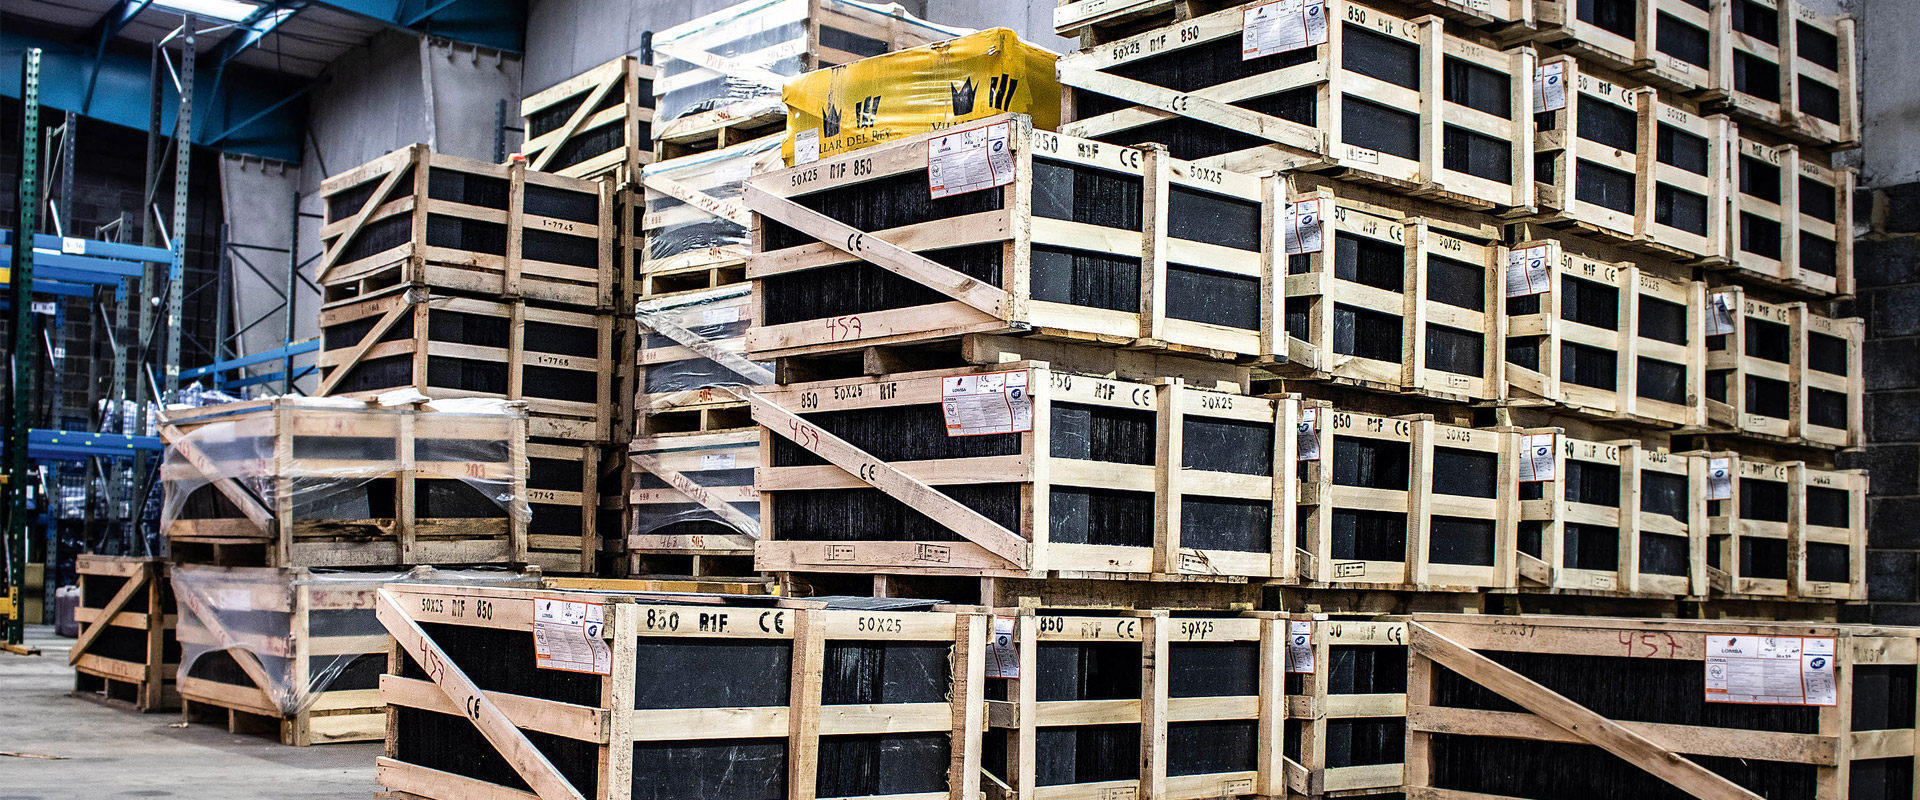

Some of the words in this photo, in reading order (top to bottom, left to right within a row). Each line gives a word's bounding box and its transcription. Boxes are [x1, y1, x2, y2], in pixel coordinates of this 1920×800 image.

[1348, 6, 1366, 24] 850
[1112, 42, 1140, 60] 50X25
[1180, 25, 1200, 43] 850
[1577, 74, 1588, 90] 50
[1621, 89, 1634, 106] CE
[1667, 108, 1687, 124] 50X25
[818, 140, 842, 154] LLAR
[846, 134, 868, 146] DEL
[1034, 132, 1058, 153] 850
[1120, 149, 1138, 169] CE
[1190, 166, 1222, 185] 50X25
[791, 168, 818, 187] 50X25
[854, 158, 872, 176] 850
[1335, 208, 1346, 222] 50
[1389, 225, 1402, 242] CE
[1438, 236, 1462, 252] 50X25
[848, 234, 862, 252] CE
[1561, 254, 1572, 269] 50
[1604, 268, 1616, 282] CE
[1640, 276, 1660, 292] 50X25
[1776, 308, 1787, 322] CE
[826, 316, 862, 341] 457
[801, 392, 818, 409] 850
[834, 384, 862, 400] 50X25
[880, 382, 897, 400] R1F
[1132, 388, 1150, 407] CE
[1202, 395, 1234, 410] 50X25
[789, 418, 818, 452] 457
[1333, 414, 1352, 429] 850
[1395, 420, 1409, 436] CE
[1446, 428, 1470, 442] 50X25
[1566, 440, 1575, 458] 50
[1606, 446, 1617, 460] CE
[860, 463, 876, 482] CE
[530, 492, 554, 500] -7742
[422, 598, 444, 614] 50X25
[476, 599, 492, 621] 850
[646, 608, 680, 632] 850
[758, 610, 785, 634] CE
[858, 616, 902, 634] 50X25
[1040, 616, 1064, 633] 850
[1116, 620, 1134, 638] CE
[1180, 620, 1214, 640] 50X25
[1330, 623, 1342, 638] 50
[1388, 626, 1402, 644] CE
[1618, 630, 1682, 659] 457
[1854, 647, 1880, 662] X37
[420, 636, 444, 688] 457
[467, 695, 480, 719] CE
